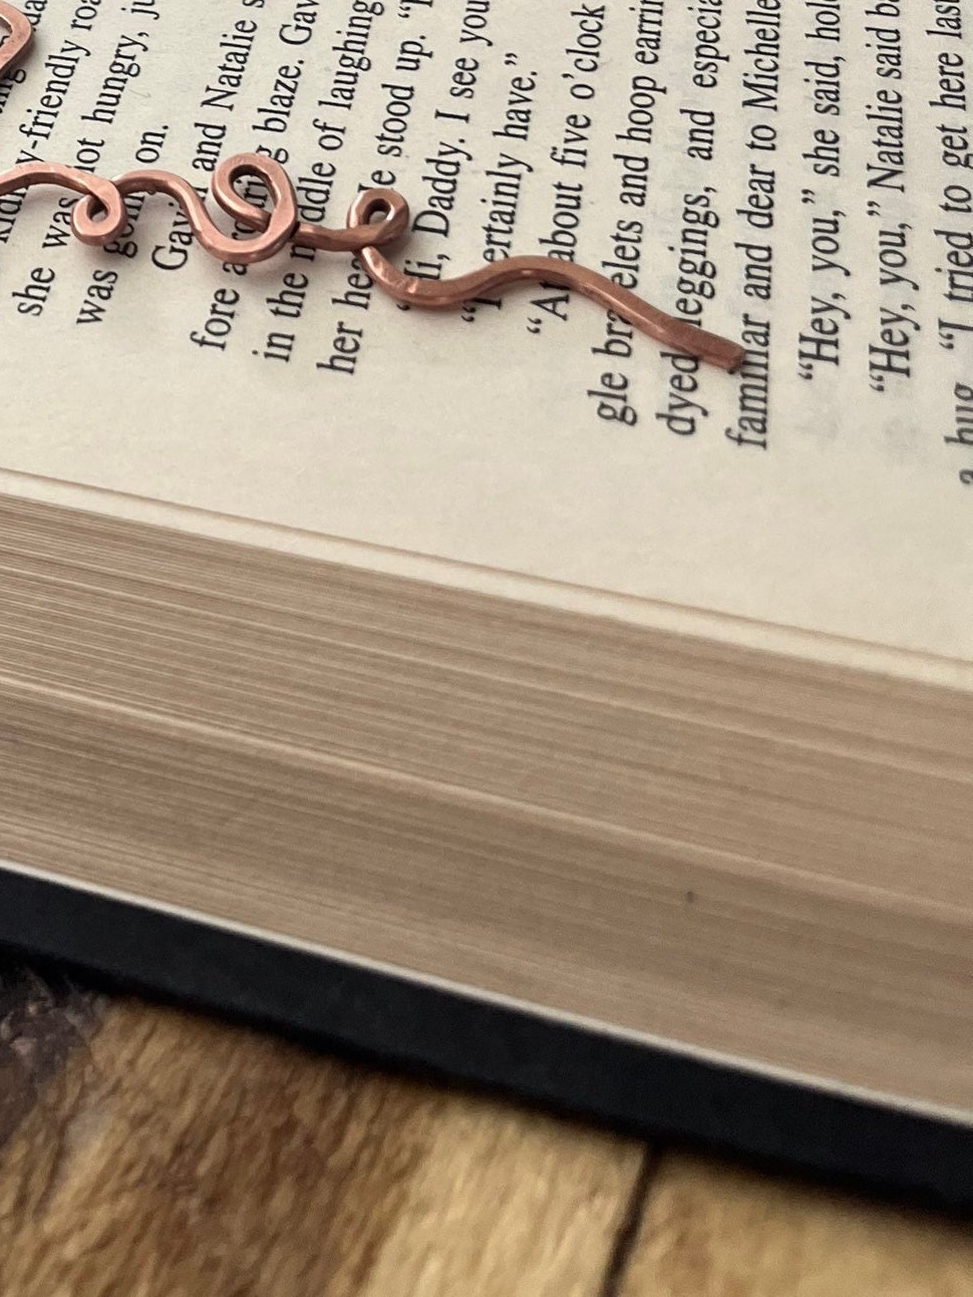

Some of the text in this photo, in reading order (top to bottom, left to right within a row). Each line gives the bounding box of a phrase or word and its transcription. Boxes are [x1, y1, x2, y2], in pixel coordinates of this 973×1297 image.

[199, 19, 257, 111] Natalie
[394, 34, 433, 71] up.
[448, 56, 480, 99] see
[864, 25, 902, 80] said
[928, 51, 967, 111] here
[614, 74, 667, 144] hoop
[802, 55, 846, 116] said,
[311, 117, 346, 151] of
[374, 82, 415, 157] stood
[433, 108, 470, 124] I
[549, 113, 592, 168] five
[678, 107, 715, 161] and
[744, 123, 777, 151] to
[865, 89, 905, 192] Natalie
[10, 266, 56, 316] she
[80, 31, 149, 124] hungry,
[191, 121, 227, 172] and
[801, 128, 840, 177] she
[935, 123, 973, 170] get
[189, 287, 240, 351] fore
[251, 59, 304, 133] blaze.
[412, 137, 473, 237] Daddy.
[480, 152, 533, 263] ertainly
[612, 153, 649, 207] and
[735, 162, 776, 229] dear
[938, 184, 973, 214] to
[75, 124, 169, 324] was on.
[537, 181, 583, 264] about
[590, 219, 643, 358] braelets
[733, 241, 773, 300] and
[933, 228, 973, 303] tried
[270, 271, 309, 318] the
[251, 331, 295, 363] in
[315, 320, 363, 375] her
[586, 371, 638, 427] gle
[655, 350, 709, 436] dyed
